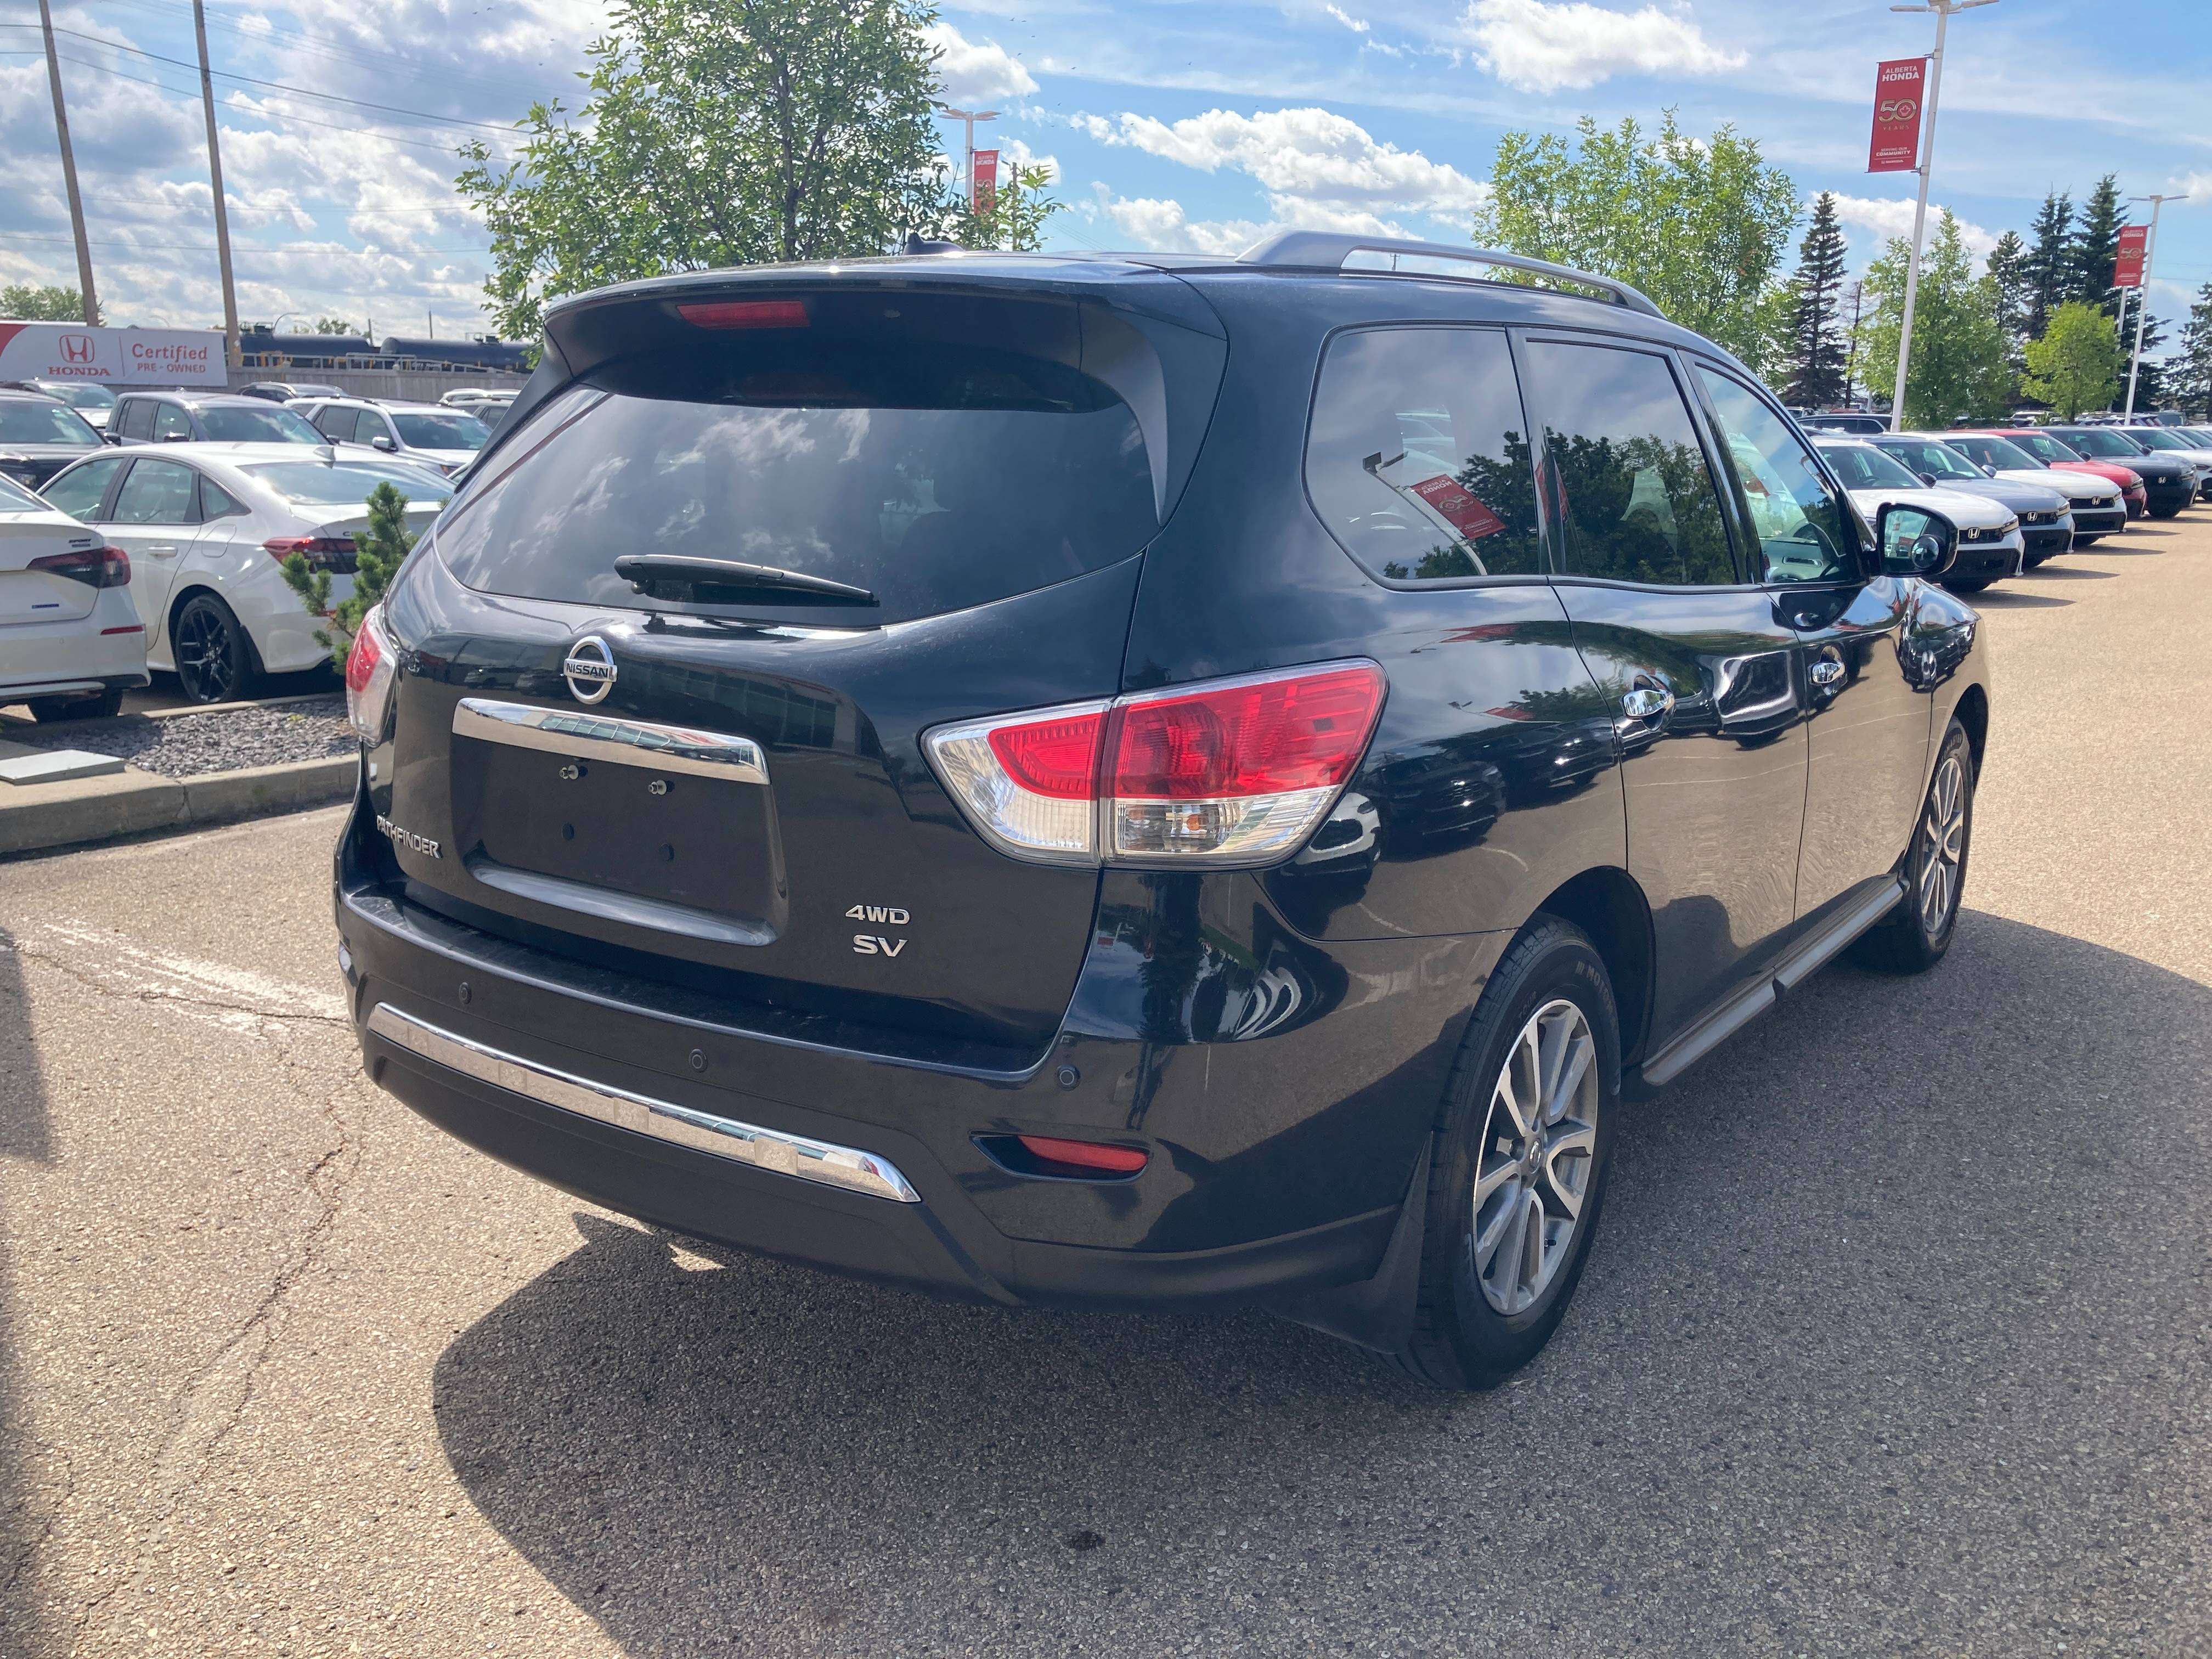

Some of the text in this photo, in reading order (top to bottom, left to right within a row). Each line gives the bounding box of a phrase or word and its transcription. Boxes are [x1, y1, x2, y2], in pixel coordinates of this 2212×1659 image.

[1882, 72, 1920, 82] HONDA
[1886, 65, 1917, 74] ALBERTA
[1878, 99, 1917, 123] 50
[2120, 247, 2142, 259] 50
[132, 343, 207, 363] Certified
[47, 366, 111, 376] HONDA
[566, 663, 608, 678] NISSAN
[376, 815, 440, 859] PATHFINDER
[845, 905, 911, 924] 4WD
[853, 934, 909, 957] SV
